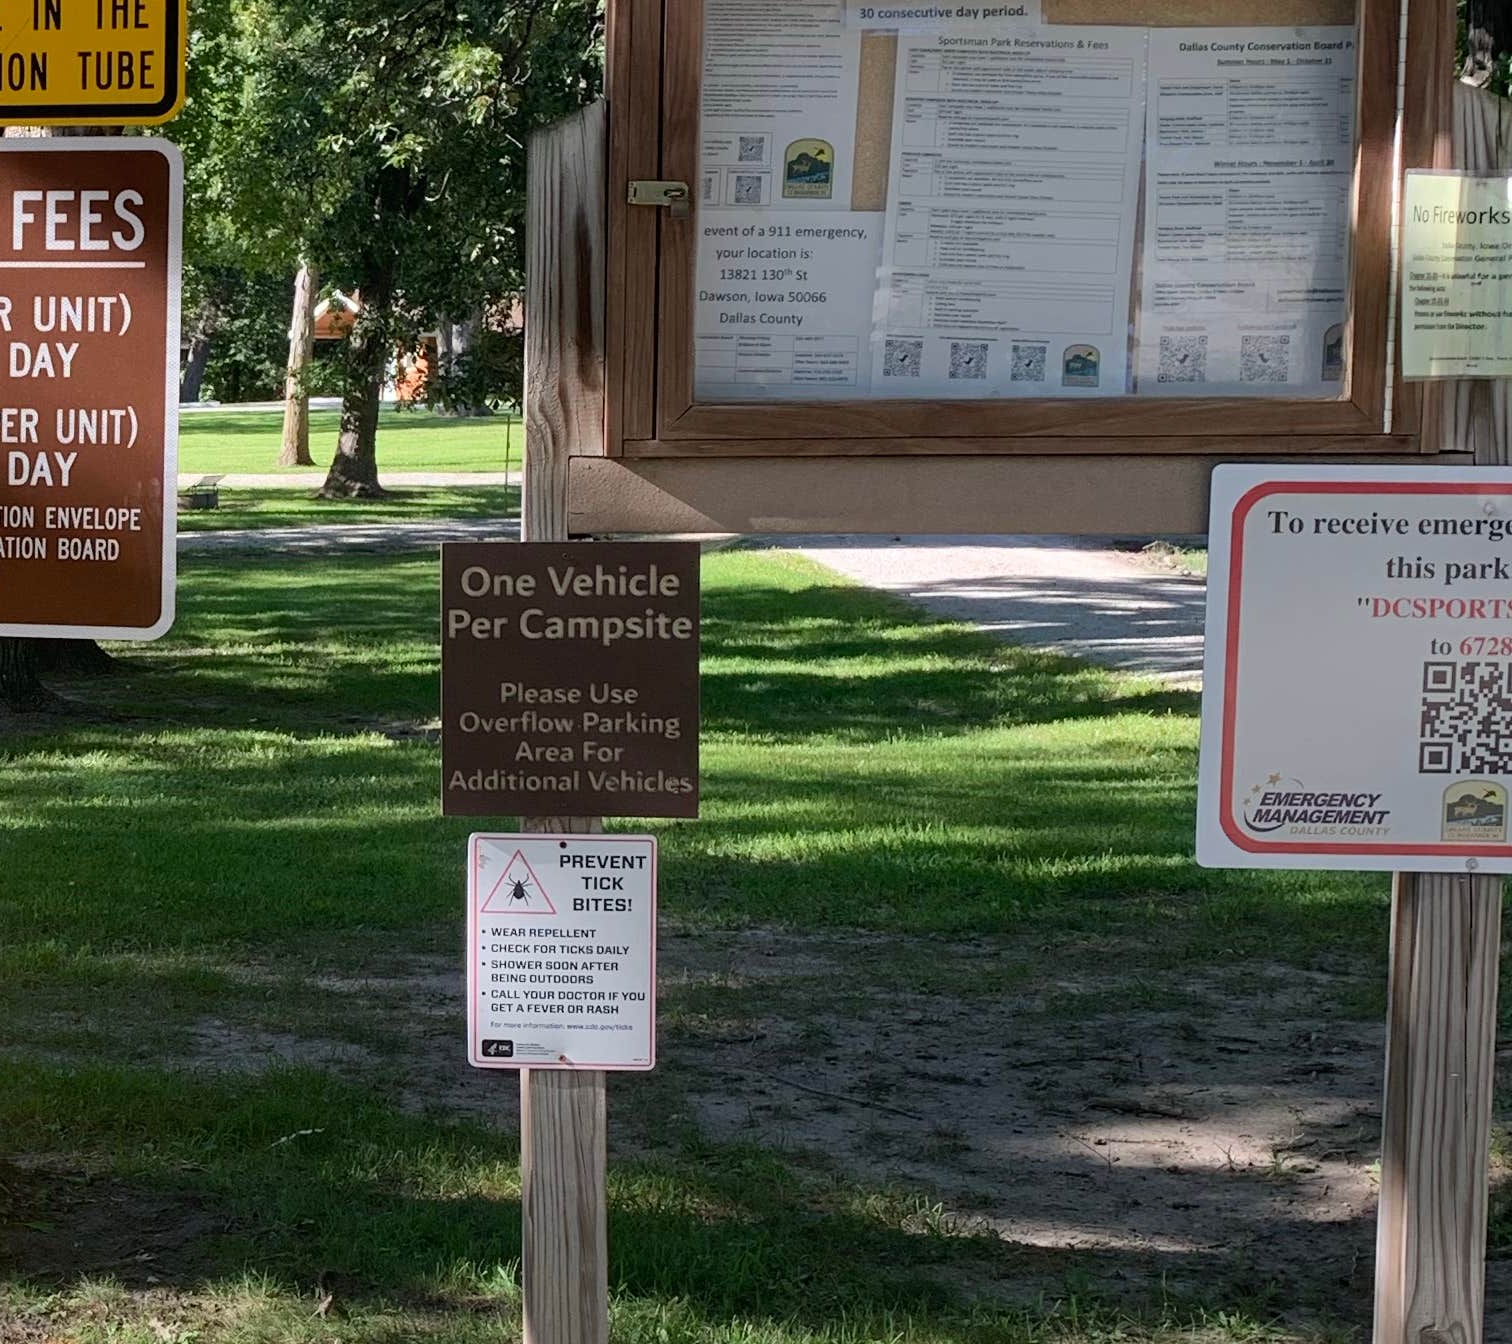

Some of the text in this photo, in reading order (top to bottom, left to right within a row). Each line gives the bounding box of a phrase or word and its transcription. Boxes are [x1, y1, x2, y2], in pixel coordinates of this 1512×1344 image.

[860, 6, 1028, 19] 30 consecutive day period.
[938, 37, 1109, 49] Sportsman Park Reservations & Fees
[1179, 42, 1208, 51] Dallas
[1211, 42, 1245, 52] County
[1248, 41, 1311, 50] Conservation
[1314, 41, 1343, 50] Board
[80, 51, 155, 90] TUBE
[13, 189, 145, 252] FEES
[1413, 206, 1511, 224] No Fireworks
[704, 227, 738, 236] event
[742, 226, 756, 236] of
[768, 227, 790, 236] 911
[796, 228, 867, 239] emergency,
[716, 249, 744, 260] your
[748, 248, 796, 258] location
[720, 269, 756, 280] 13821
[796, 270, 808, 280] St
[700, 291, 826, 303] Dawson, Iowa 50066
[34, 293, 132, 336] UNIT)
[720, 313, 803, 326] Dallas County
[9, 342, 79, 377] DAY
[56, 406, 138, 447] UNIT)
[8, 452, 77, 486] DAY
[46, 507, 141, 531] ENVELOPE
[1268, 511, 1303, 534] To
[1314, 512, 1409, 535] receive
[58, 538, 119, 561] BOARD
[1386, 556, 1510, 585] this park
[461, 566, 681, 598] One Vehicle
[447, 609, 691, 646] Per Campsite
[1431, 638, 1452, 656] to
[500, 683, 639, 705] Please Use
[459, 712, 681, 739] Overflow Parking
[515, 742, 624, 763] Area For
[448, 770, 692, 794] Additional Vehicles
[1260, 792, 1382, 807] EMERGENCY
[1252, 809, 1391, 825] MANAGEMENT
[1339, 827, 1391, 836] COUNTY
[560, 855, 646, 869] PREVENT
[581, 877, 624, 890] TICK
[573, 898, 632, 911] BITES!
[491, 928, 596, 938] WEAR REPELLENT
[491, 944, 629, 955] CHECK FOR TICKS DAILY
[491, 960, 618, 971] SHOWER SOON AFTER
[491, 974, 594, 984] BEING OUTDOORS
[491, 990, 645, 1001] CALL YOUR DOCTOR IF YOU
[491, 1004, 619, 1014] GET A FEVER OR RASH
